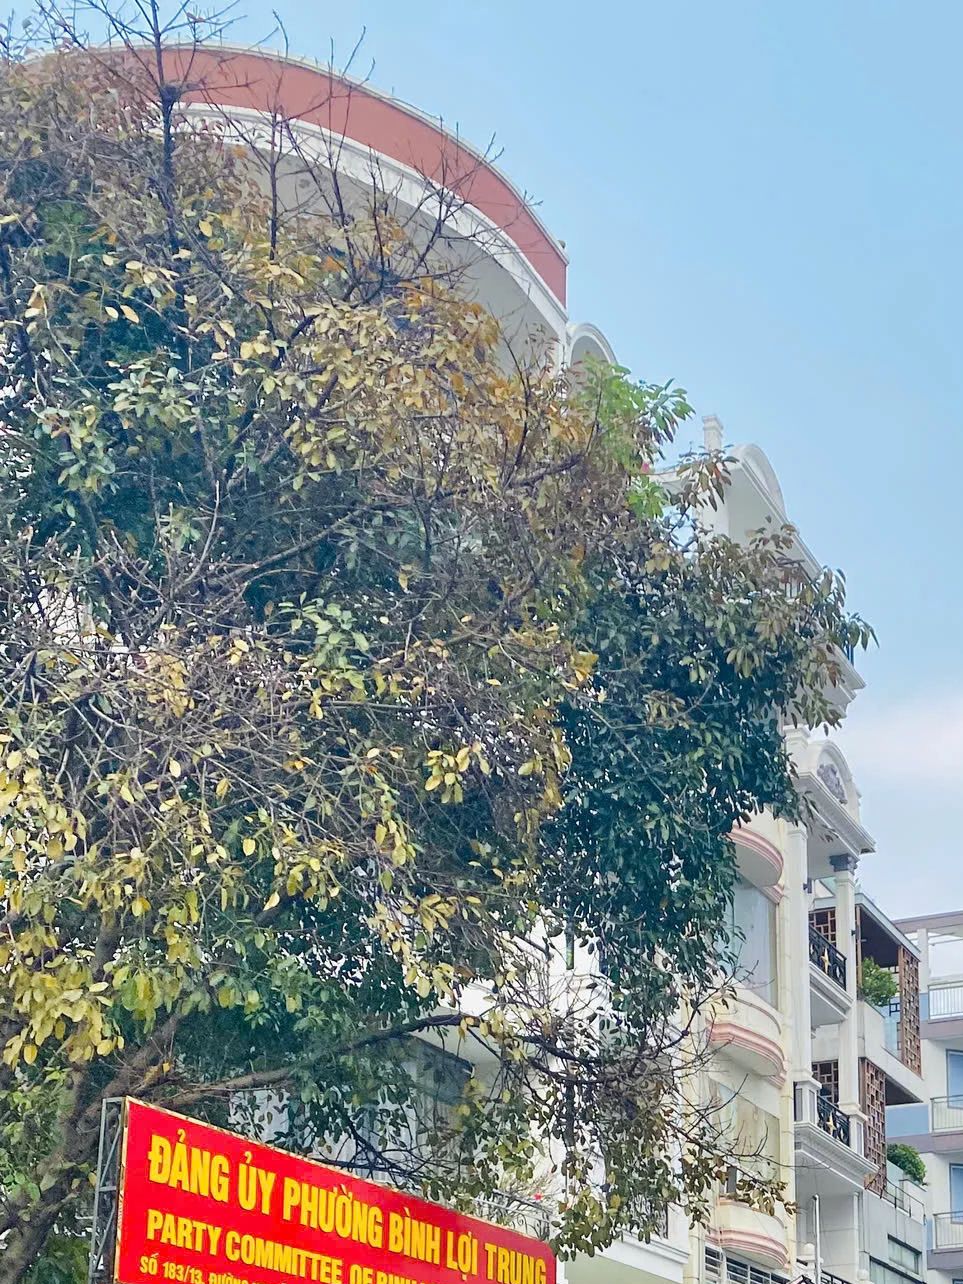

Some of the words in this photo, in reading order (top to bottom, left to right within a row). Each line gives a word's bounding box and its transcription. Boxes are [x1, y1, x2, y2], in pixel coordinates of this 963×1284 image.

[148, 1129, 229, 1203] ĐẢNG
[238, 1151, 276, 1215] ỦY
[282, 1177, 383, 1248] PHƯỜNG
[389, 1207, 440, 1264] BÌNH
[447, 1231, 478, 1281] LỢI
[147, 1209, 222, 1256] PARTY
[140, 1253, 158, 1275] SỐ
